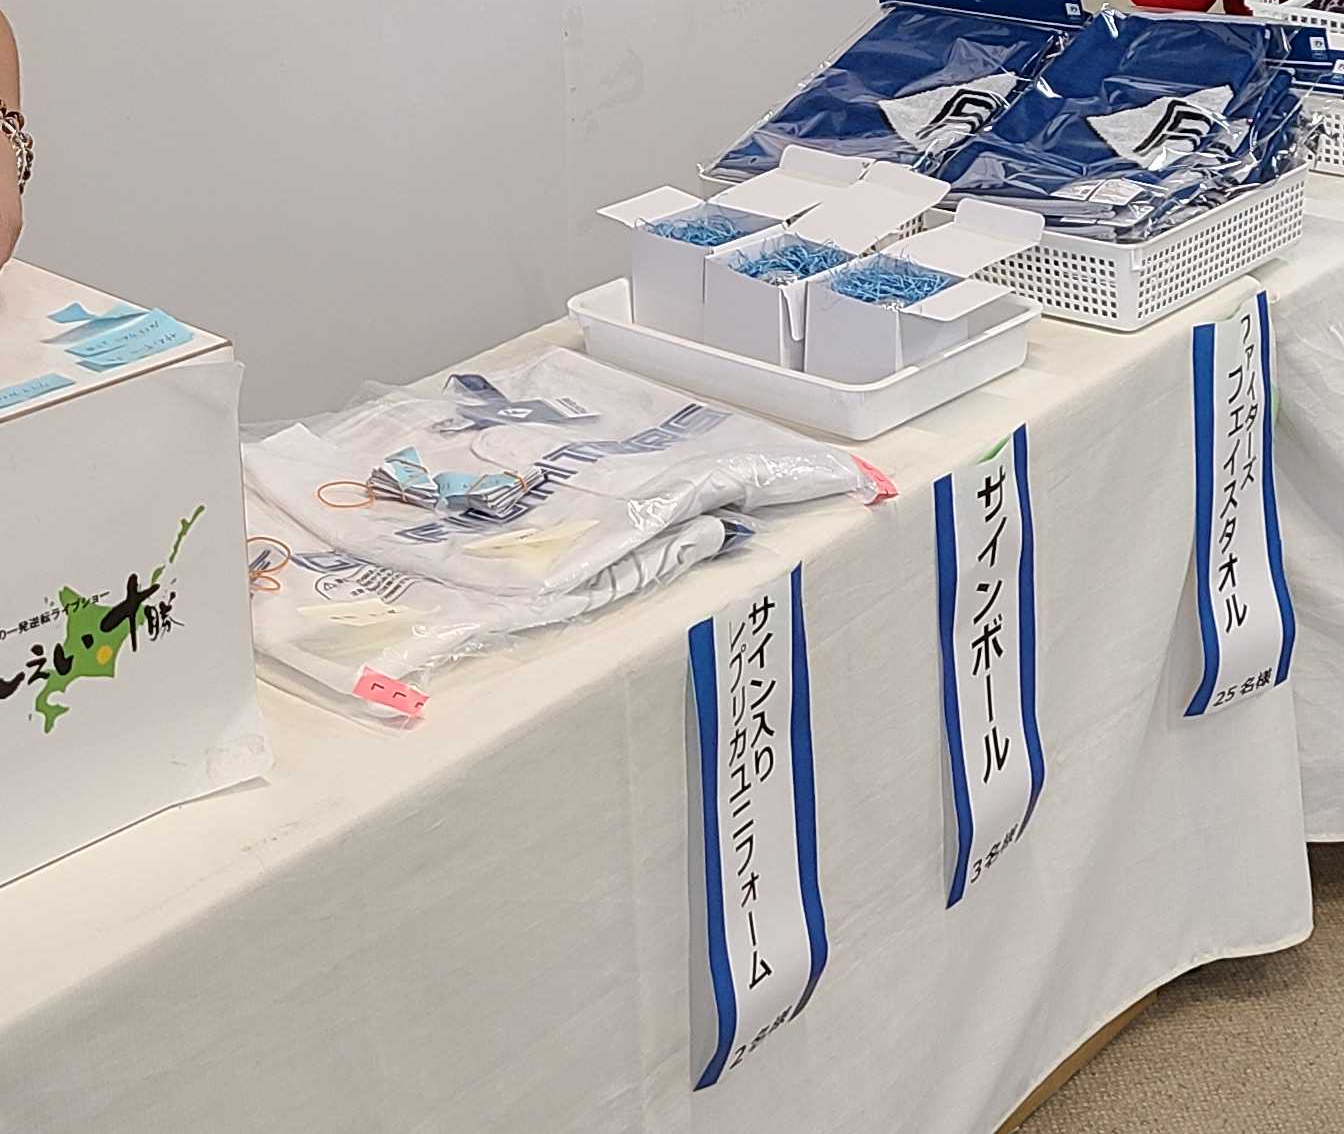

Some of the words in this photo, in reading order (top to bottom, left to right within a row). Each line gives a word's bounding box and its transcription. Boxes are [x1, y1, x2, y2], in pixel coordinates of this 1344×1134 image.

[1239, 313, 1259, 491] ファイターズ
[748, 594, 776, 783] サイン入り
[971, 465, 1010, 784] サインボール
[1212, 667, 1272, 708] 25名様
[728, 620, 772, 991] レプリカユニフォーム
